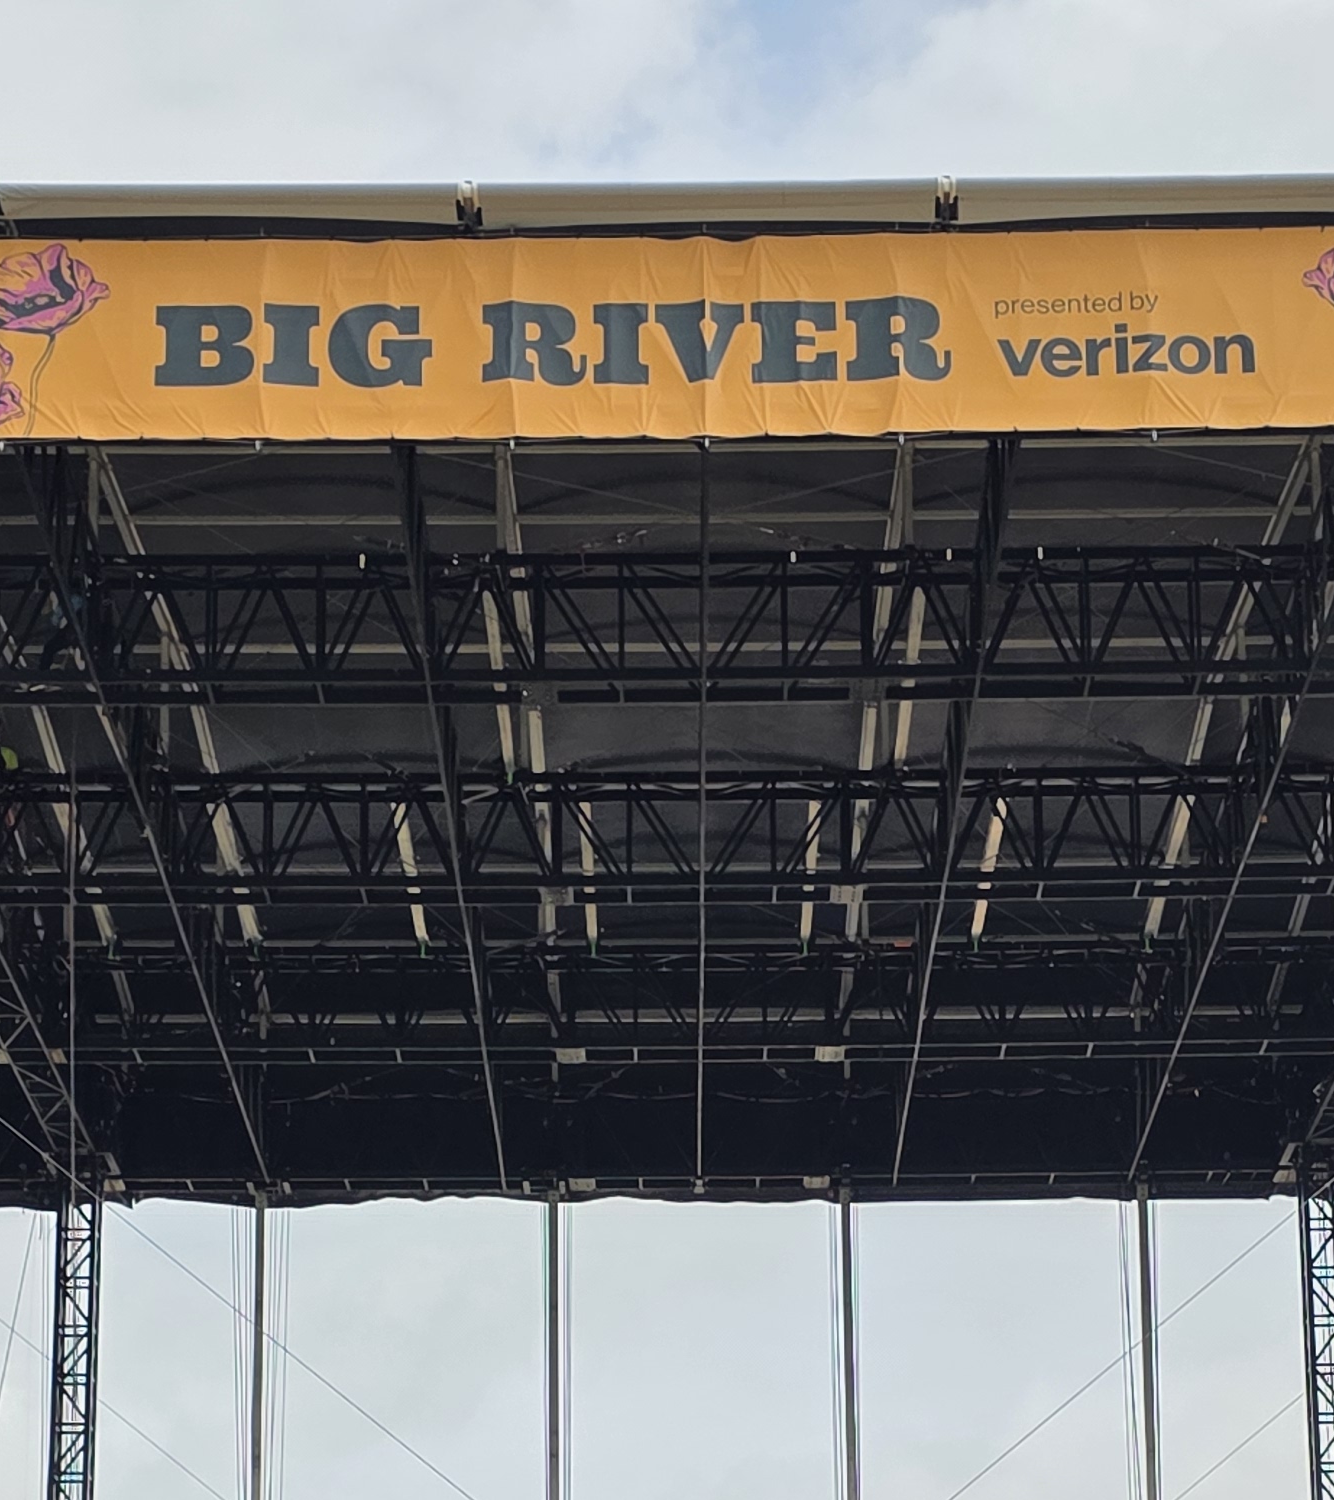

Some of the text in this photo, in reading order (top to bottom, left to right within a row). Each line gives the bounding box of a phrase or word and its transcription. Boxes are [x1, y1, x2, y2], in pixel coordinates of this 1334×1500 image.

[994, 290, 1158, 318] presented by
[154, 296, 953, 388] BIG RIVER
[997, 323, 1256, 378] verizon
